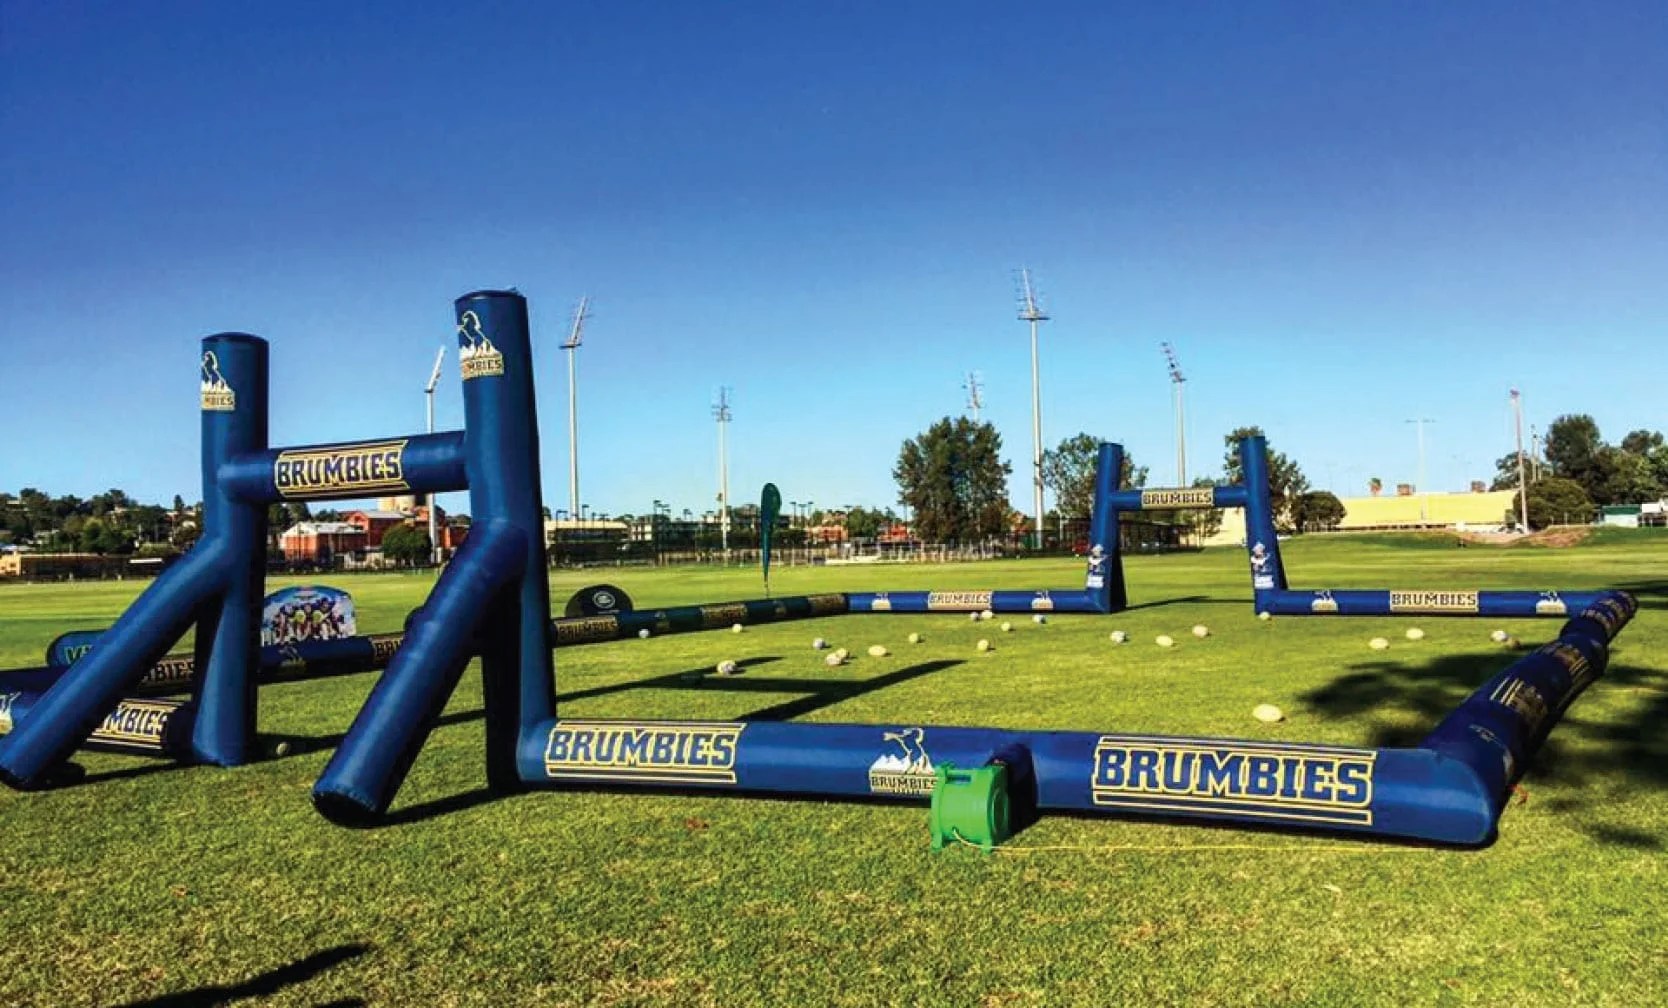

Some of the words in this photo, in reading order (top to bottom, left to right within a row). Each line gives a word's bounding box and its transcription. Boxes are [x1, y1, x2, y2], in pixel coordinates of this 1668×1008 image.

[276, 451, 401, 487] BRUMBIES
[1143, 491, 1212, 505] BRUMBIES
[1391, 592, 1477, 606] BRUMBIES
[549, 729, 735, 767] BRUMBIES
[1098, 749, 1370, 806] BRUMBIES
